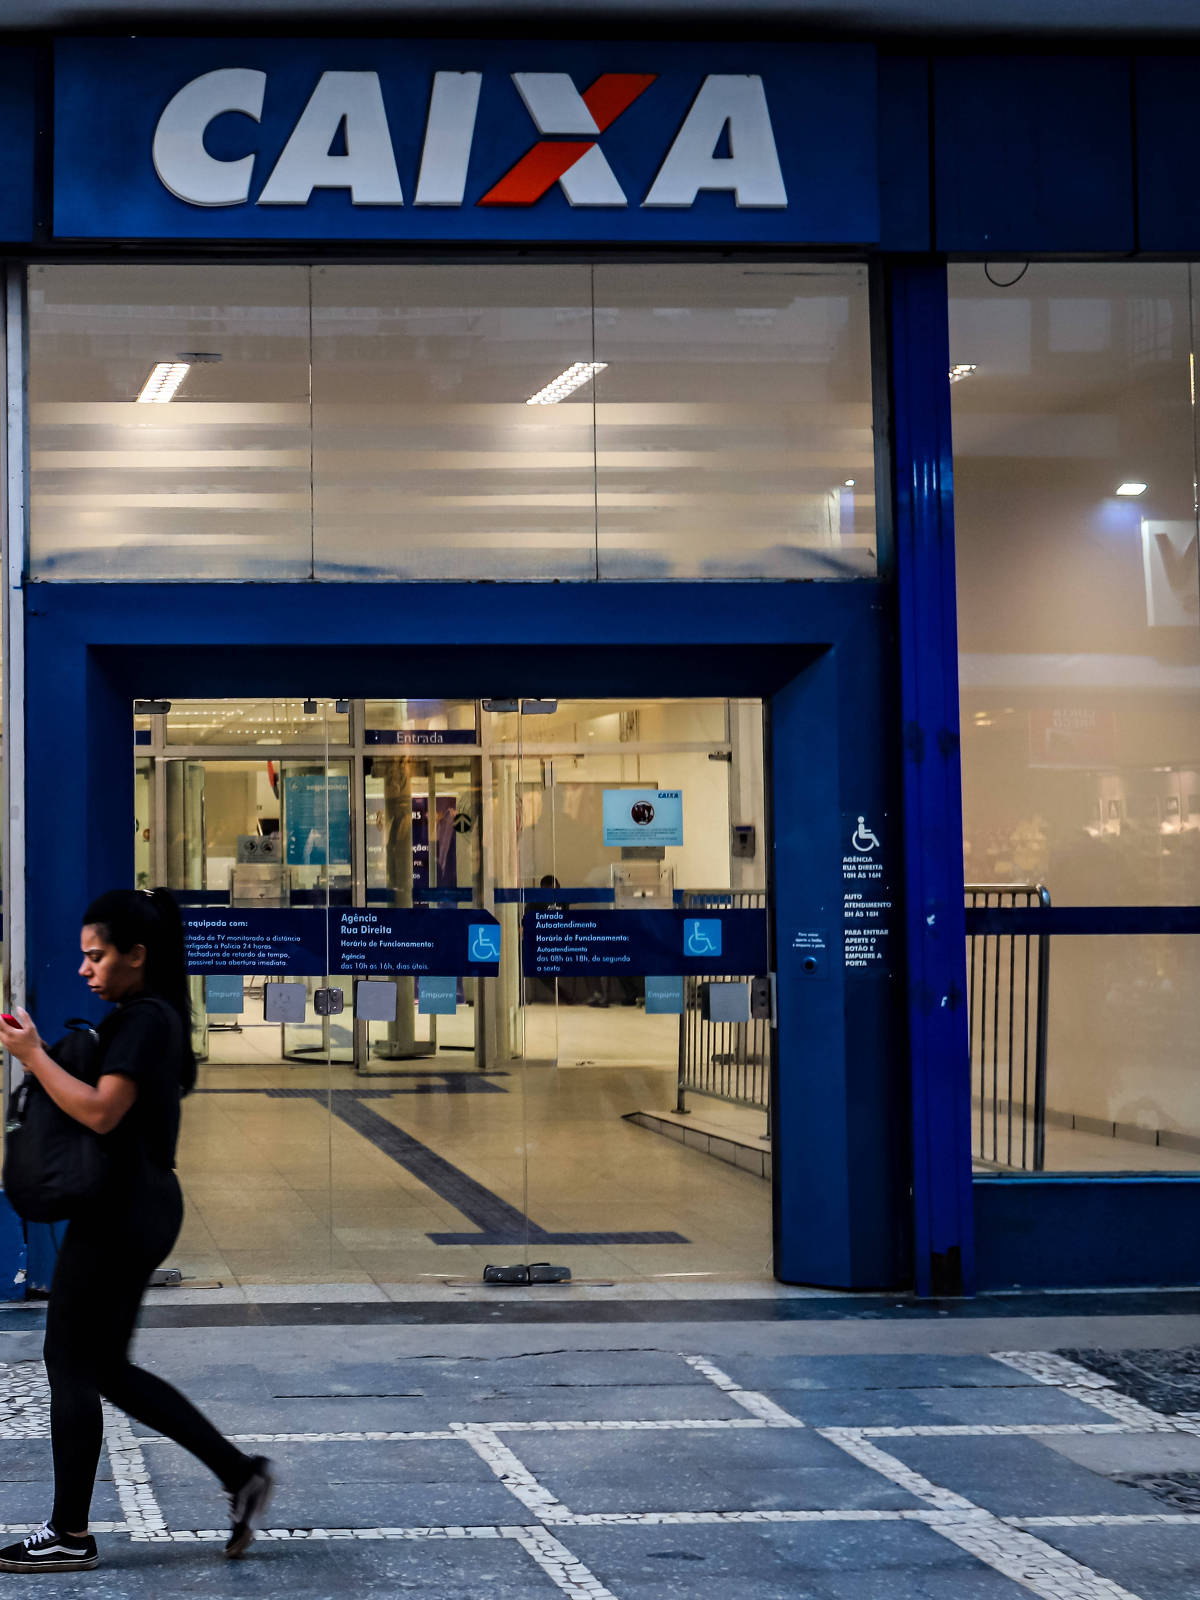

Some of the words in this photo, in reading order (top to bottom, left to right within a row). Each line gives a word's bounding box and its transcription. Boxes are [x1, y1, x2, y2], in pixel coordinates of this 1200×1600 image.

[151, 67, 789, 208] CAIXA
[396, 731, 444, 743] Entrada
[341, 913, 378, 925] Agência
[535, 912, 563, 920] Entrada
[188, 919, 227, 928] equipada
[535, 920, 597, 929] Autoatendimento
[340, 925, 358, 934] Rua
[360, 925, 392, 934] Direita
[536, 934, 563, 942] Horário
[564, 934, 573, 942] de
[574, 934, 629, 942] Funcionamento:
[340, 939, 367, 947] Horário
[368, 939, 378, 947] de
[379, 940, 434, 948] Funcionamento:
[341, 953, 366, 961] Agência
[602, 955, 631, 964] segunda
[340, 962, 353, 970] das
[355, 962, 368, 970] 10h
[396, 962, 410, 970] dias
[421, 990, 454, 1000] Empurre
